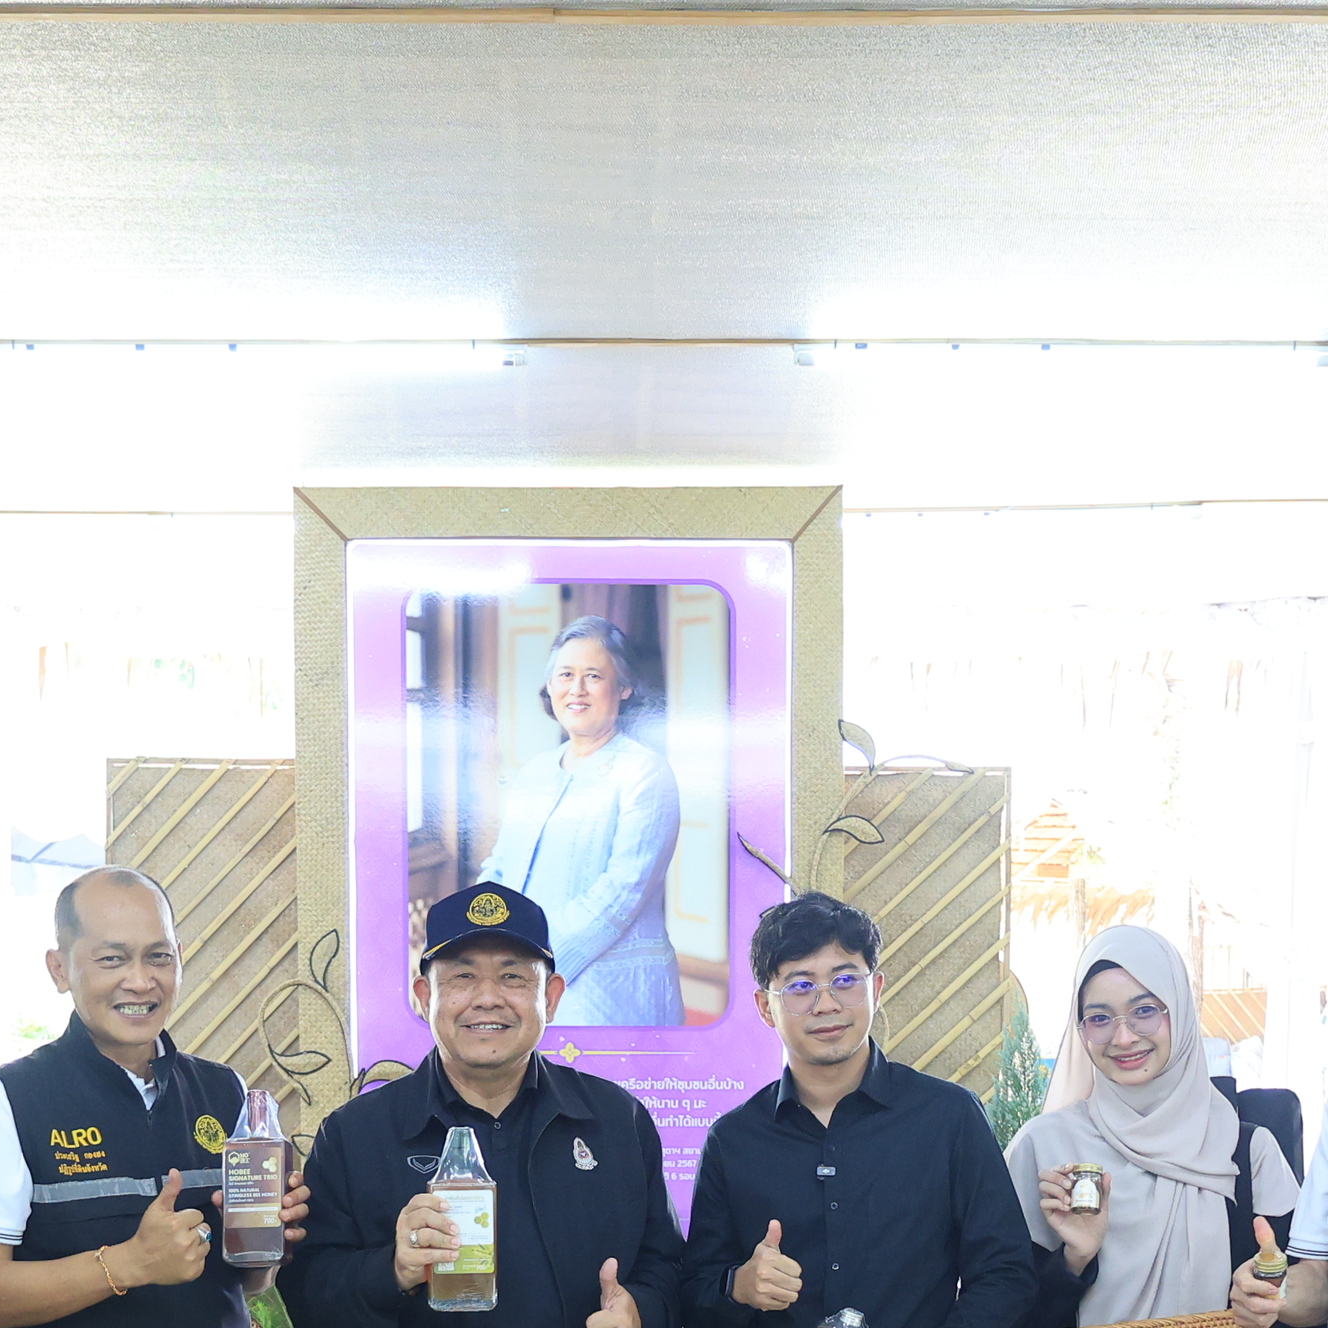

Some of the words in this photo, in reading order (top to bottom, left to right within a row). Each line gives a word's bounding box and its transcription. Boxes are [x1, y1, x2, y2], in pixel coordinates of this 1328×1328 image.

[615, 1074, 745, 1093] เครือข่ายให้ชุมชนอื่นบ้าง
[50, 1126, 103, 1148] ALRO
[677, 1160, 697, 1168] 2567
[671, 1172, 677, 1180] 6
